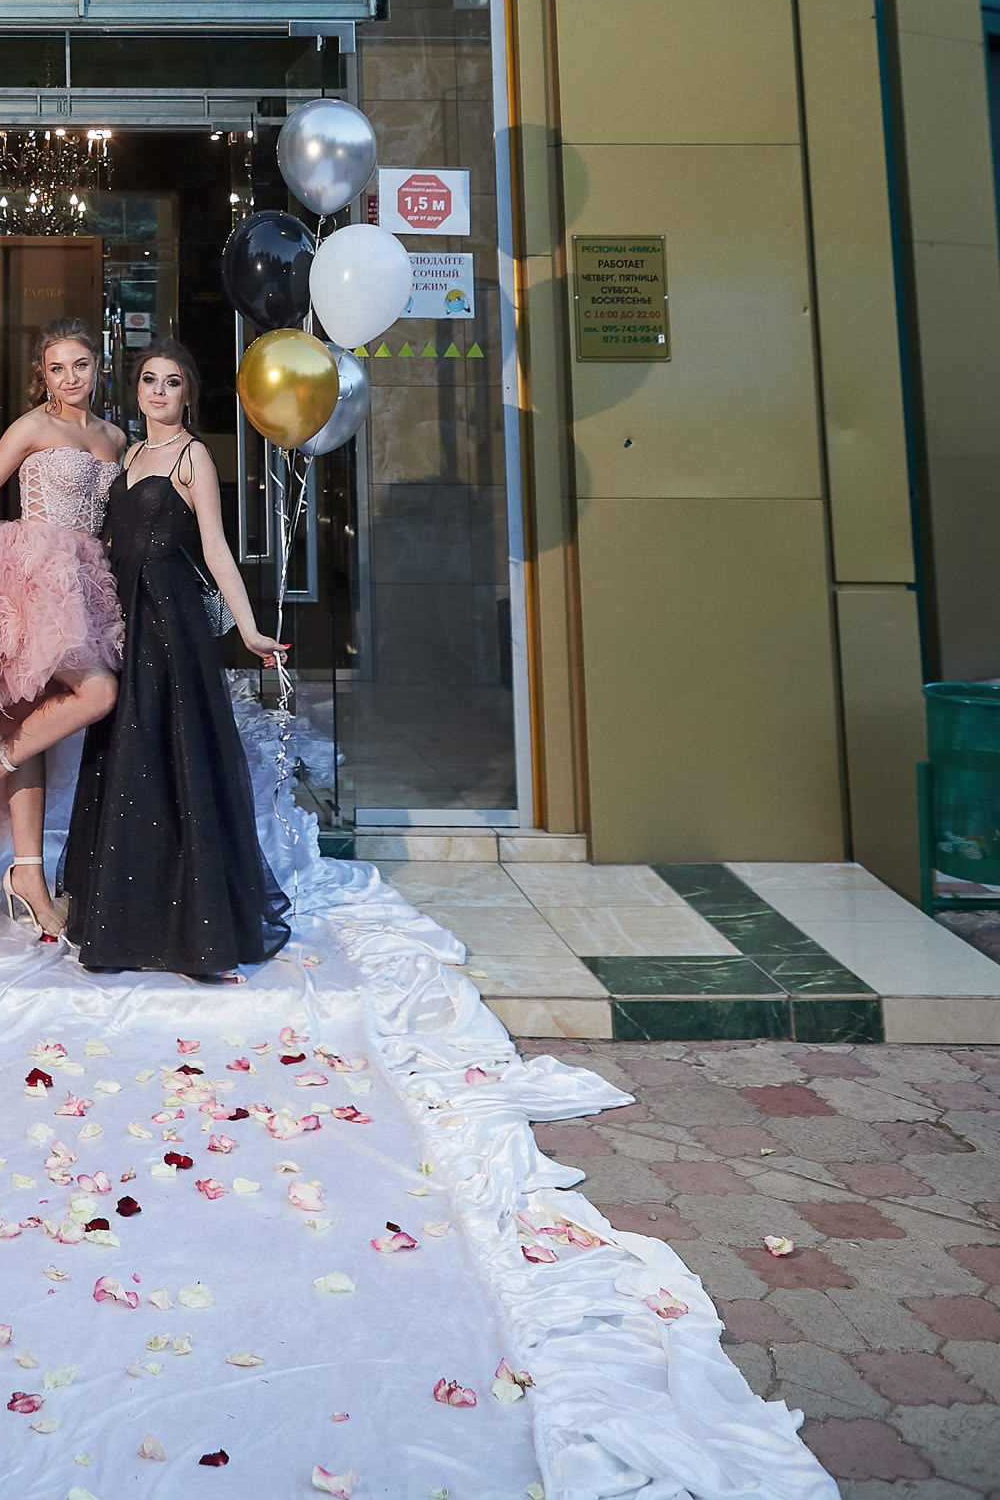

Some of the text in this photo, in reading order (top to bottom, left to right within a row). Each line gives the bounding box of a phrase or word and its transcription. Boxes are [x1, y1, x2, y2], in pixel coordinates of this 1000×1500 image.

[404, 196, 428, 213] 1,5
[581, 245, 627, 253] РЕСТОРАН
[597, 259, 645, 269] РАБОТАЕТ
[412, 269, 459, 278] СОЧНЫЙ
[582, 274, 659, 283] ЧЕТВЕРГ, ПЯТНИЦА
[412, 282, 447, 291] ЕЖИМ
[601, 286, 641, 295] СУББОТА,
[591, 296, 652, 305] ВОСКРЕСЕНЬЕ
[594, 310, 618, 319] 16:00
[620, 310, 634, 320] ДО
[637, 310, 661, 319] 22:00
